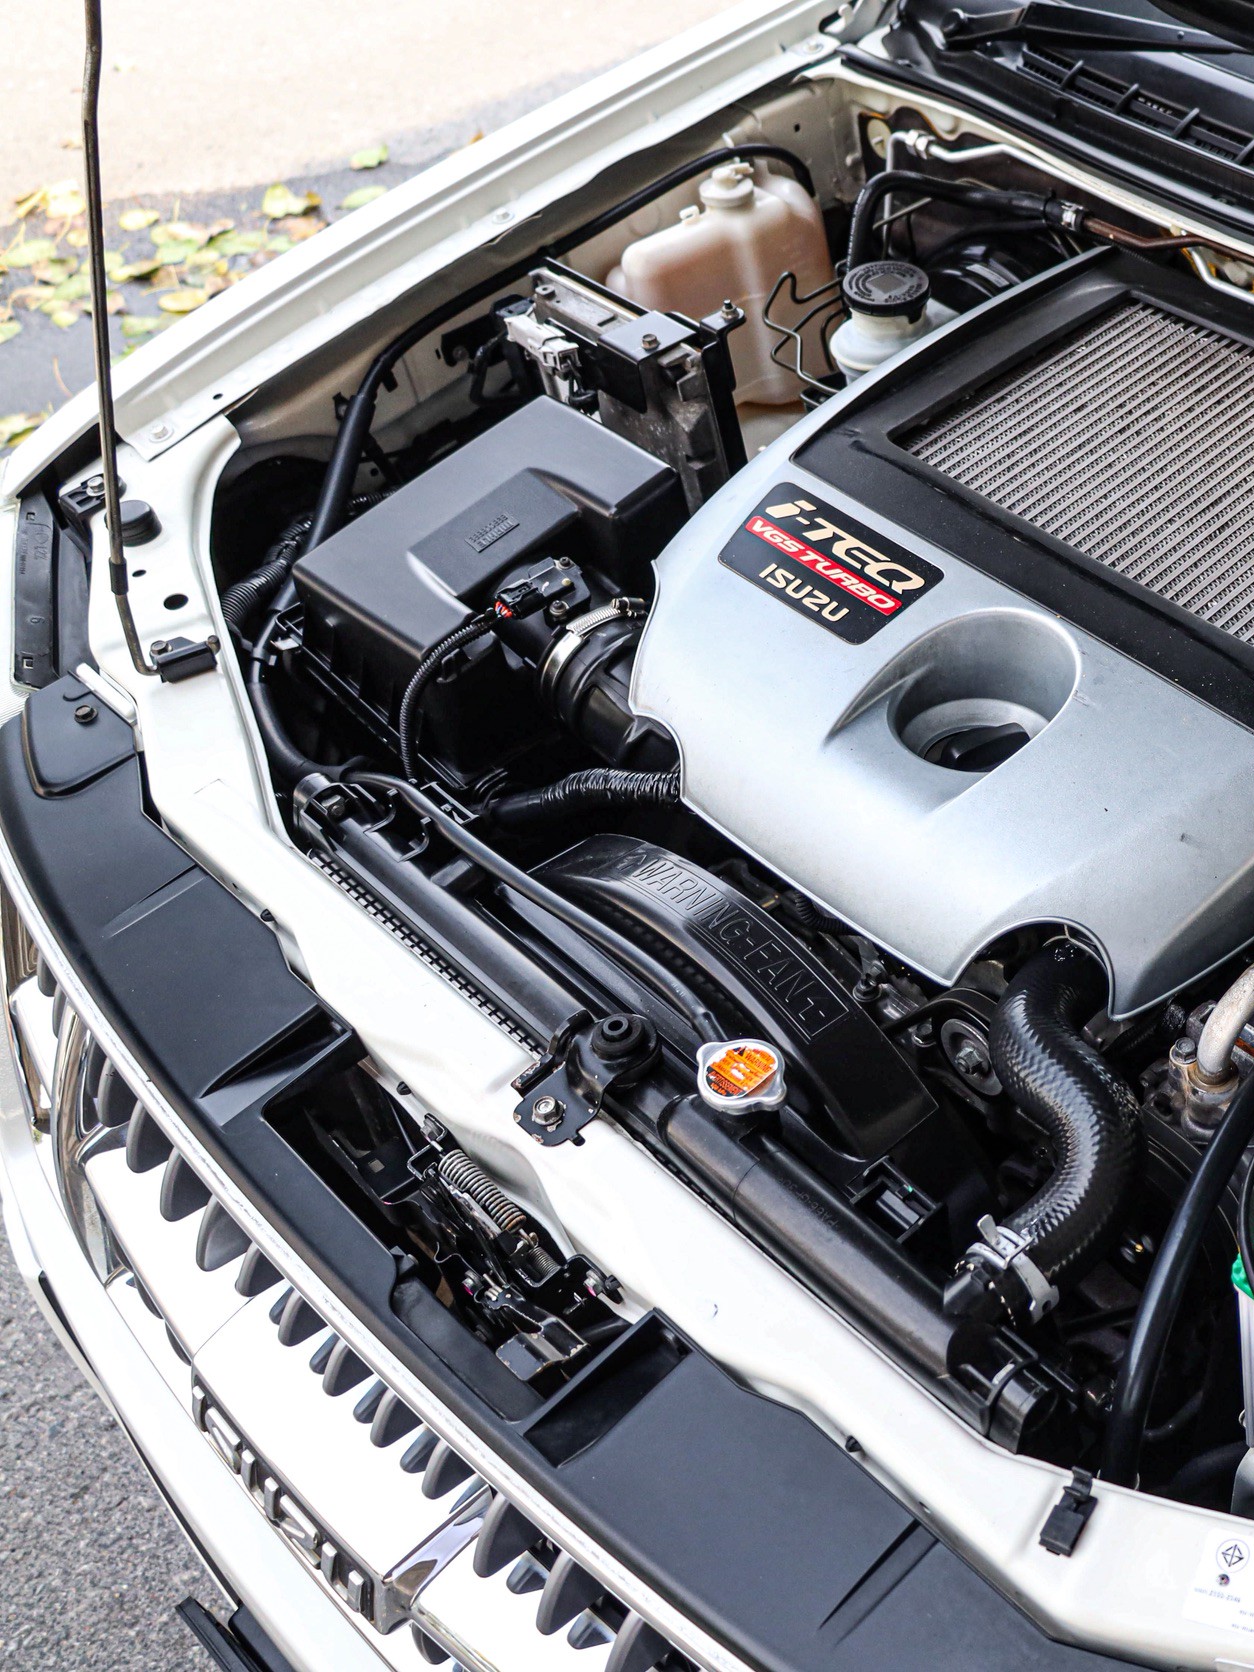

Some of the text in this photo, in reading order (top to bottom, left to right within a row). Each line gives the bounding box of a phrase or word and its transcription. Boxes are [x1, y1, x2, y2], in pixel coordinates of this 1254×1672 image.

[751, 519, 896, 609] VGS TURBO
[758, 563, 850, 623] ISUZU
[745, 1051, 772, 1074] WARNING
